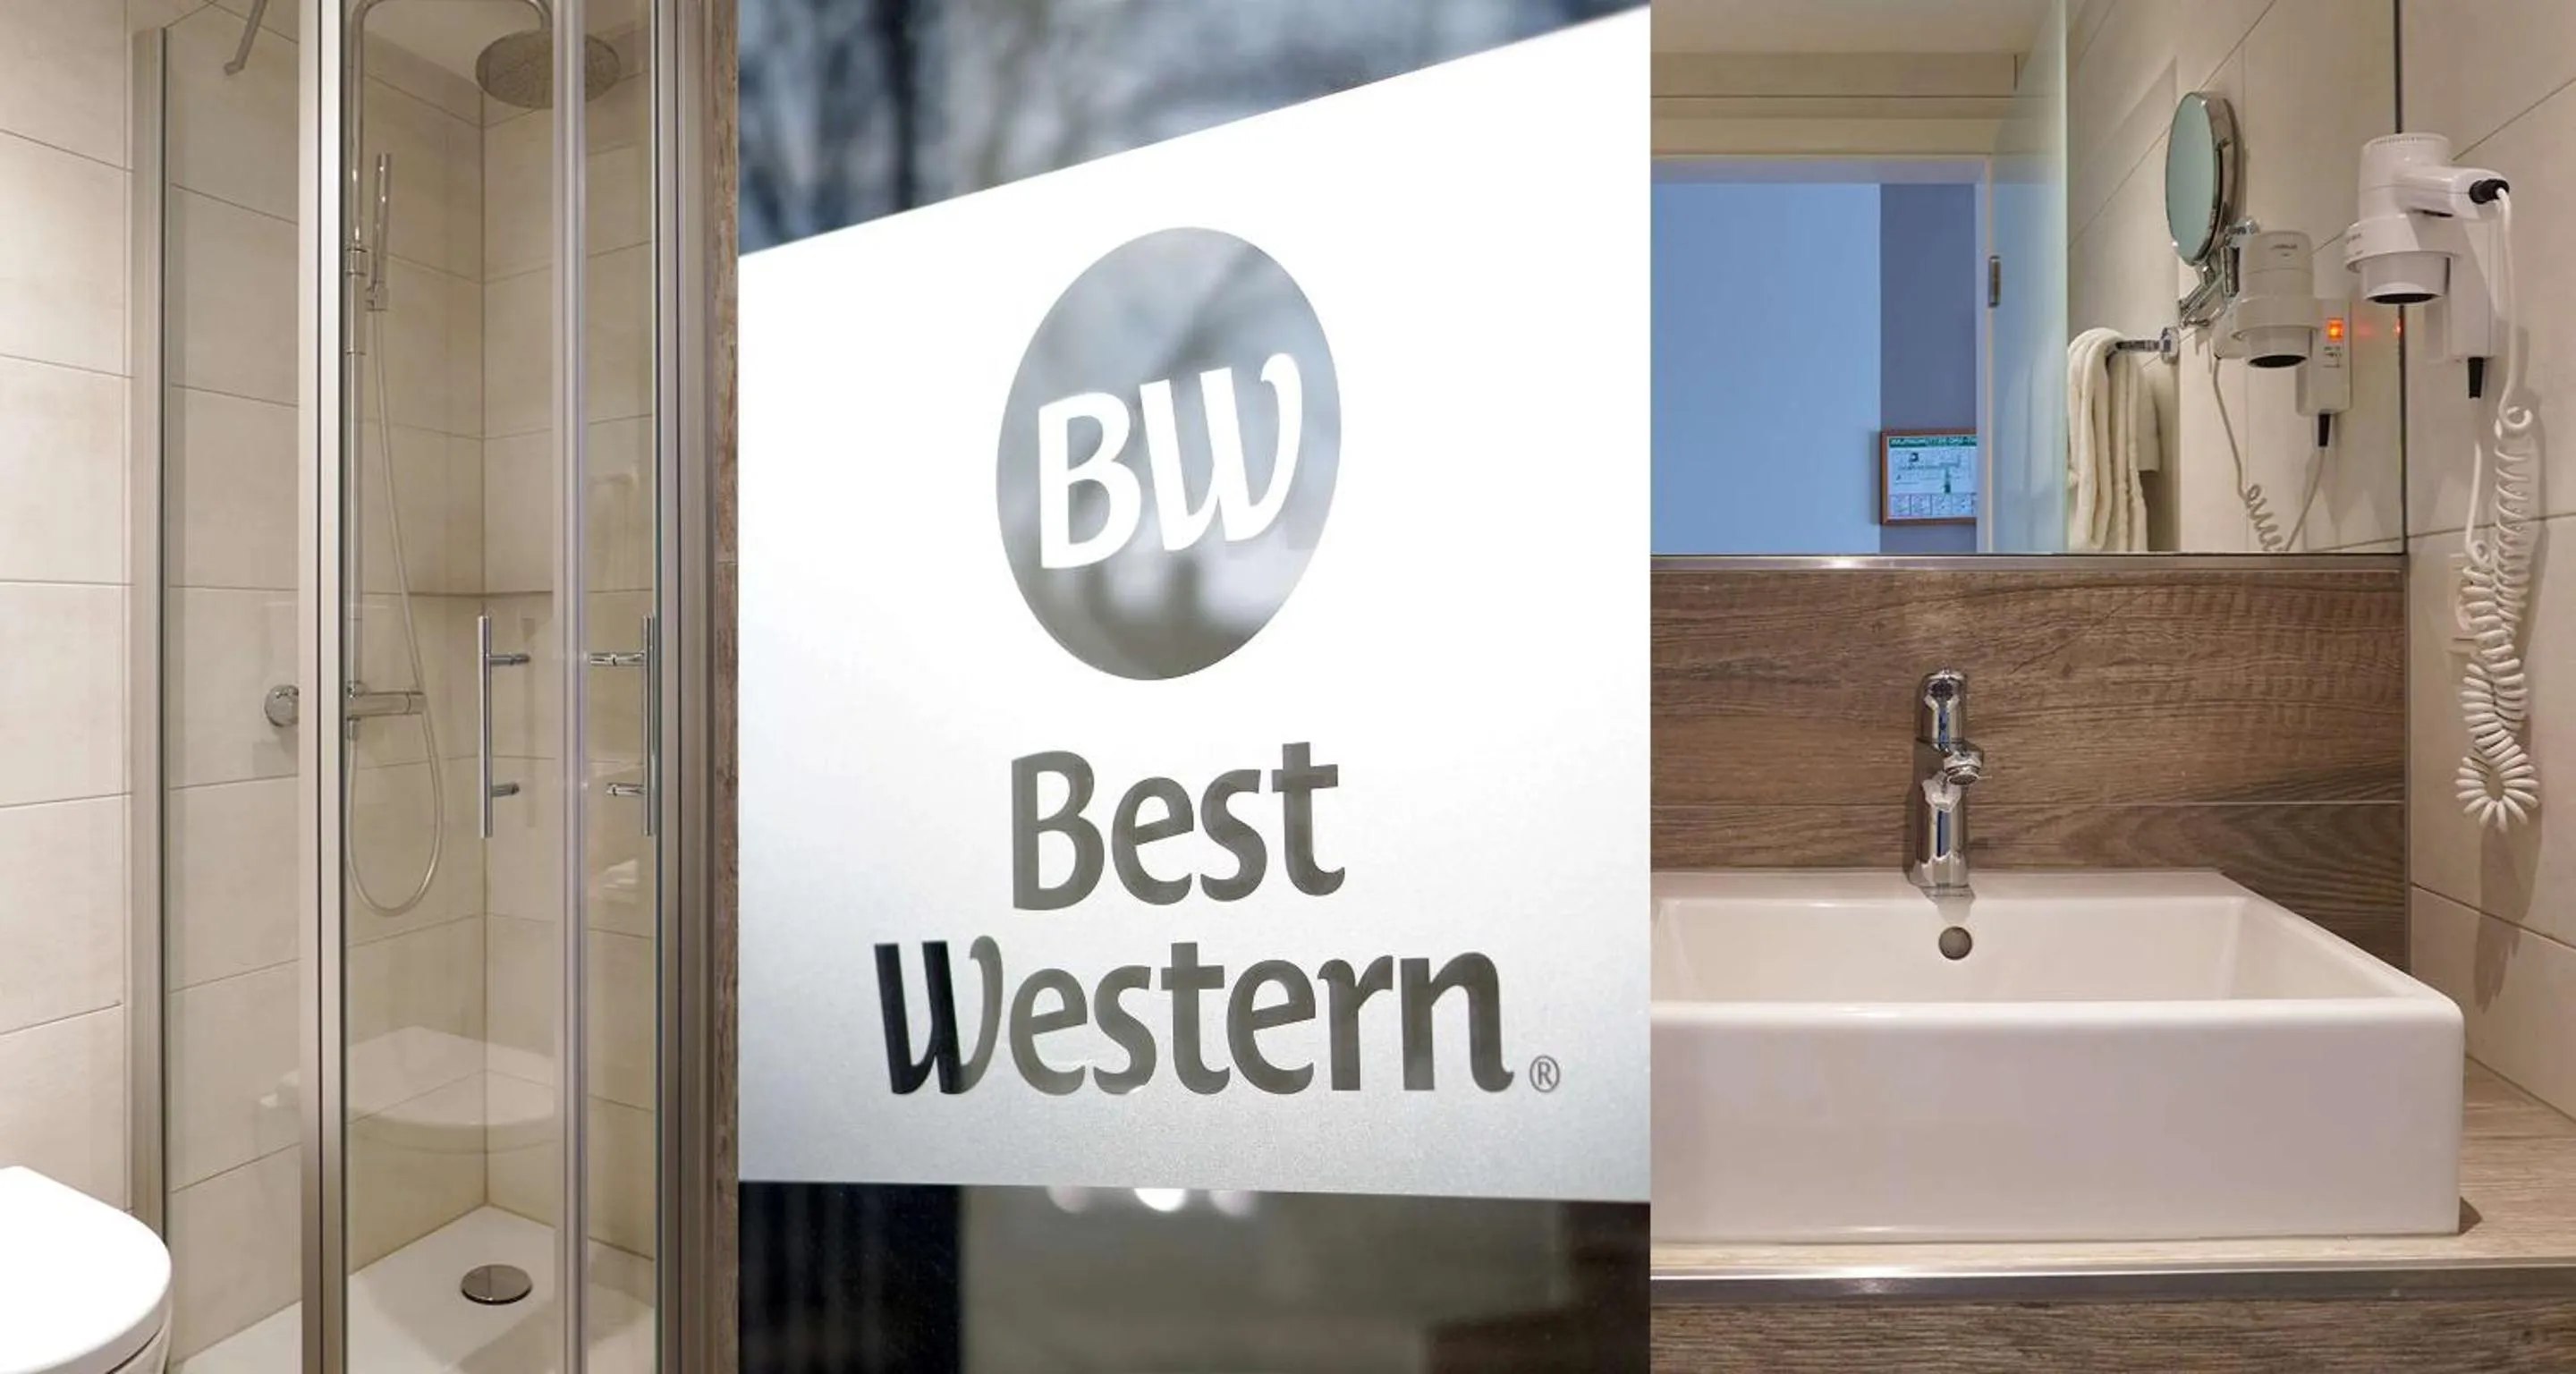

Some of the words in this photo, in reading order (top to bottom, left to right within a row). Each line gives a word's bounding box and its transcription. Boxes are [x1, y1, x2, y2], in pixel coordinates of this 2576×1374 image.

[1038, 352, 1302, 569] BW
[1012, 742, 1345, 911] Best
[874, 935, 1514, 1096] Western
